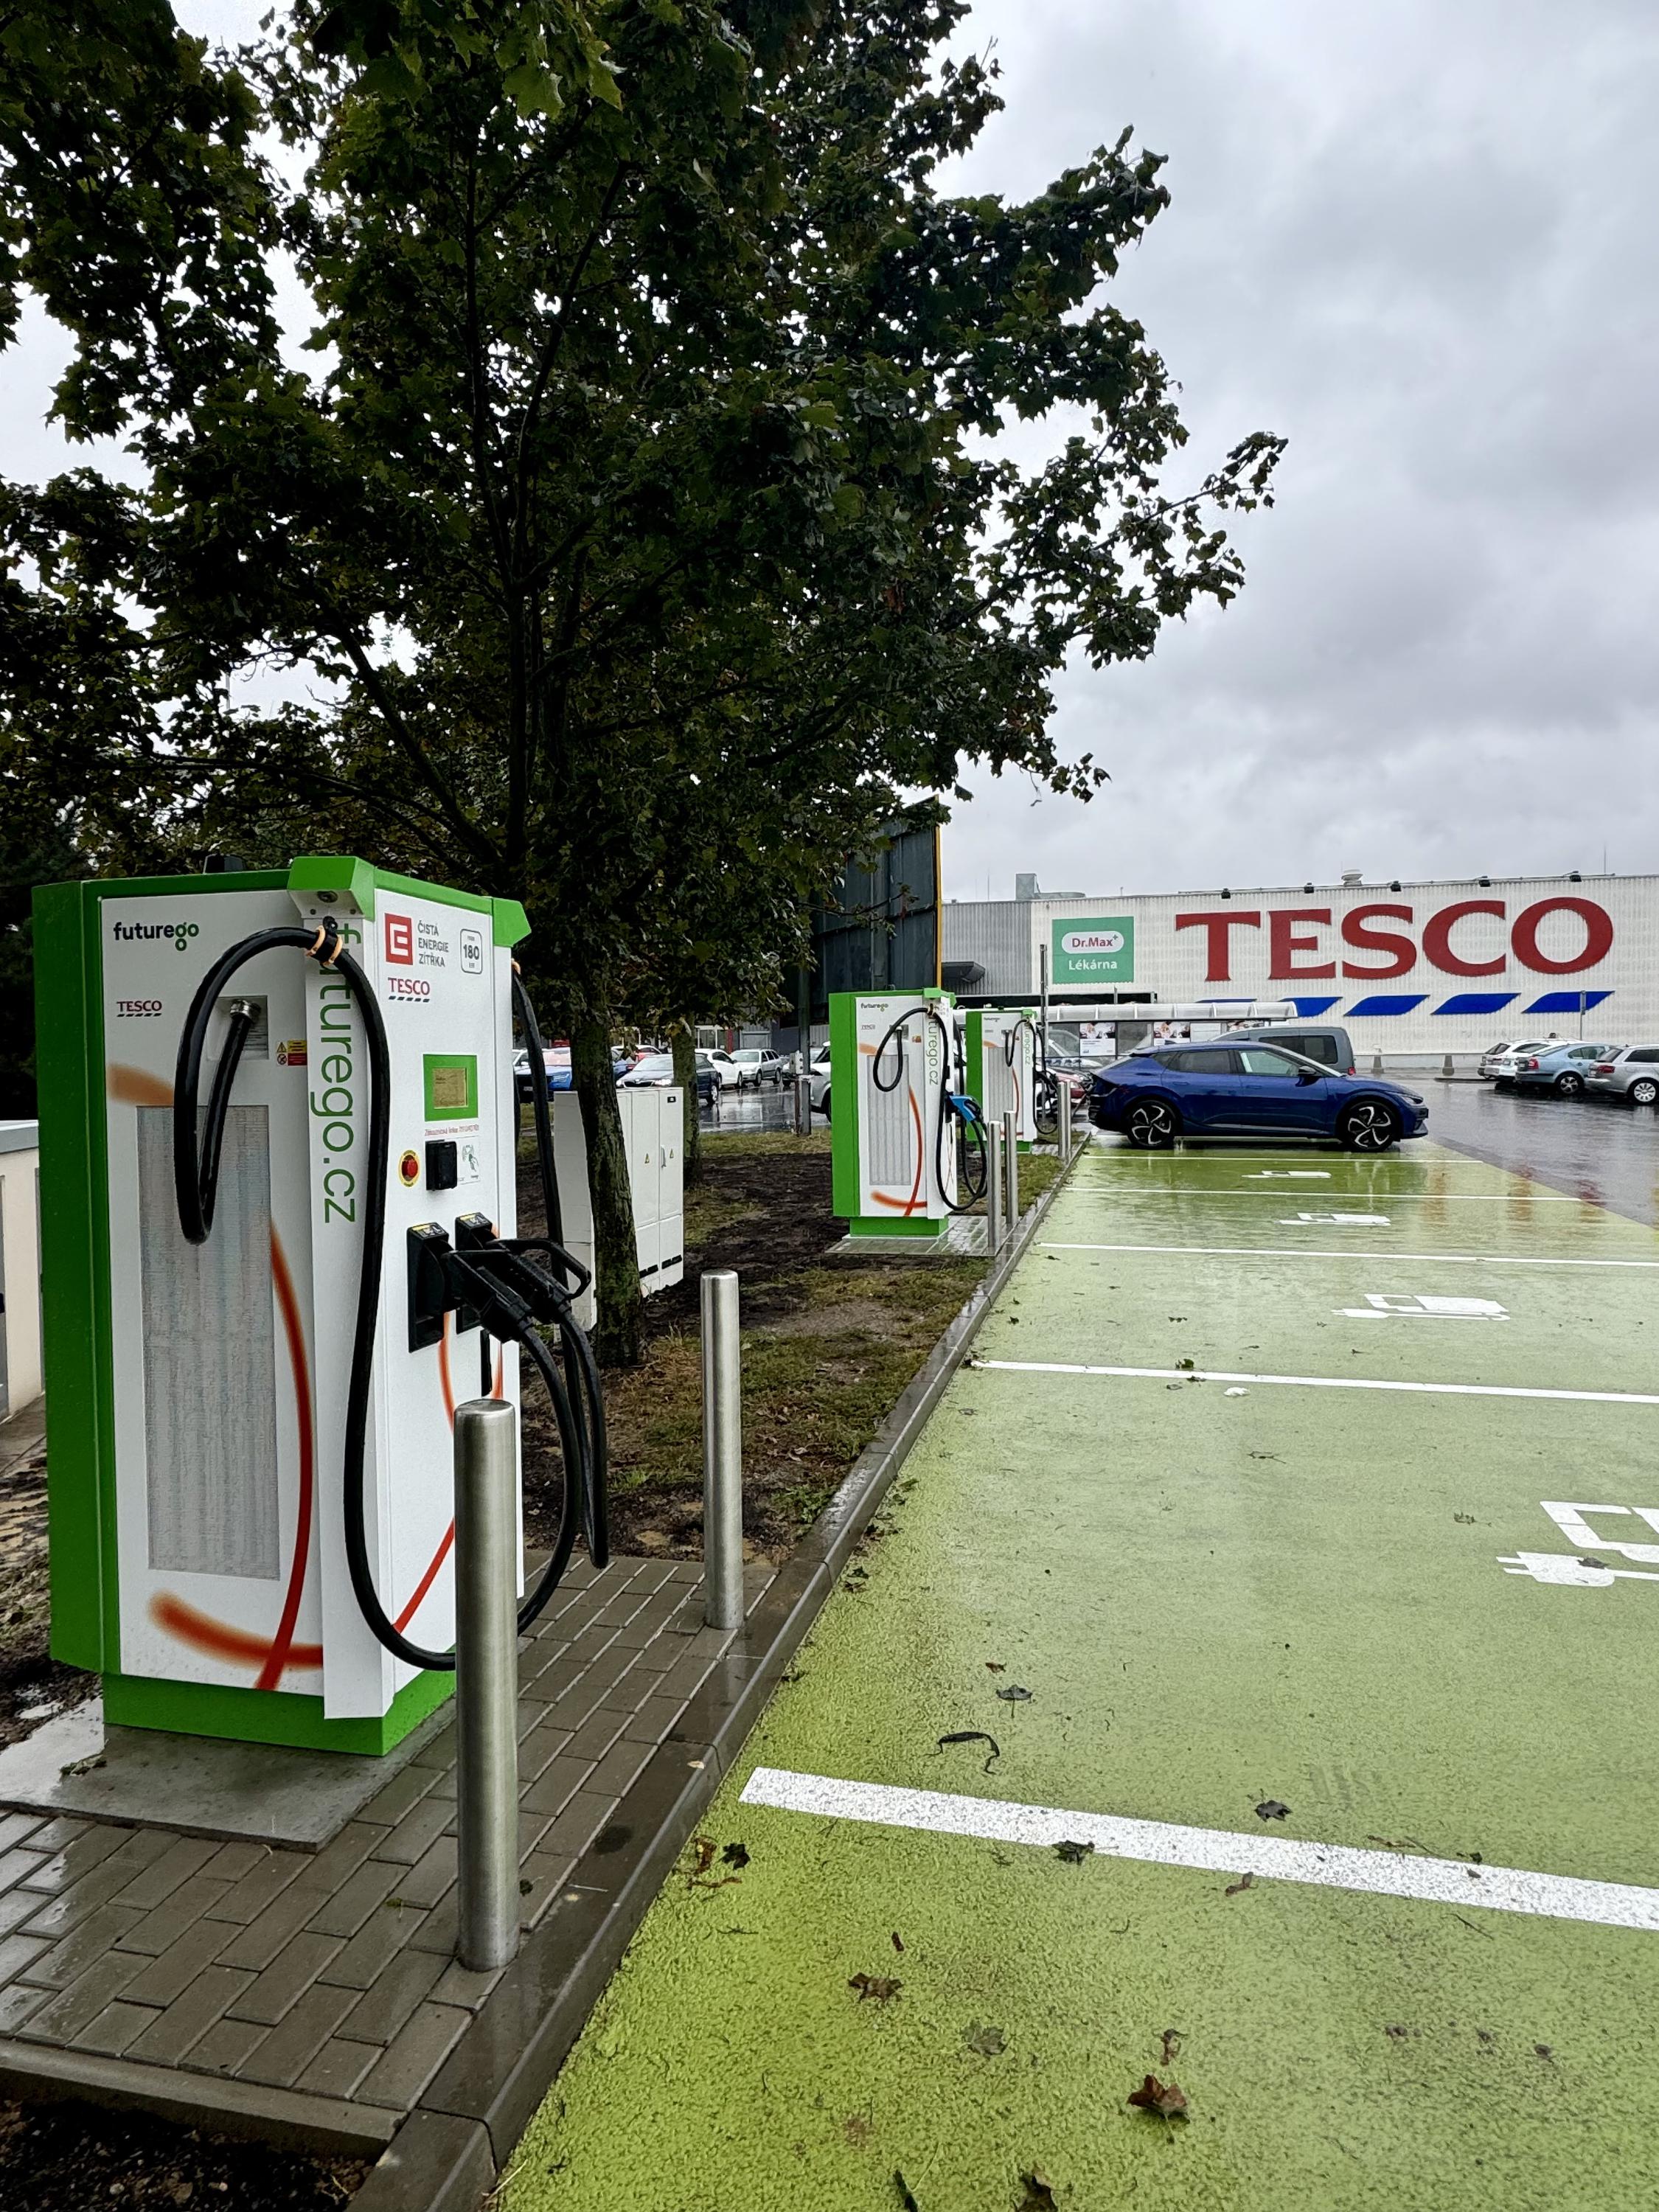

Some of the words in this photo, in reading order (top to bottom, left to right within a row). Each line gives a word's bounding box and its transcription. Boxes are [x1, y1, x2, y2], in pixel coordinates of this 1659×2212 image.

[417, 919, 439, 936] ČISTÁ
[113, 922, 199, 951] futurego
[1071, 936, 1114, 948] Dr.Max
[1175, 897, 1613, 982] TESCO
[418, 937, 449, 953] ENERGIE
[463, 944, 479, 960] 180
[418, 951, 445, 967] ZÍTŘKA
[1068, 959, 1118, 971] Lékárna
[388, 977, 431, 995] TESCO
[116, 1000, 162, 1012] TESCO
